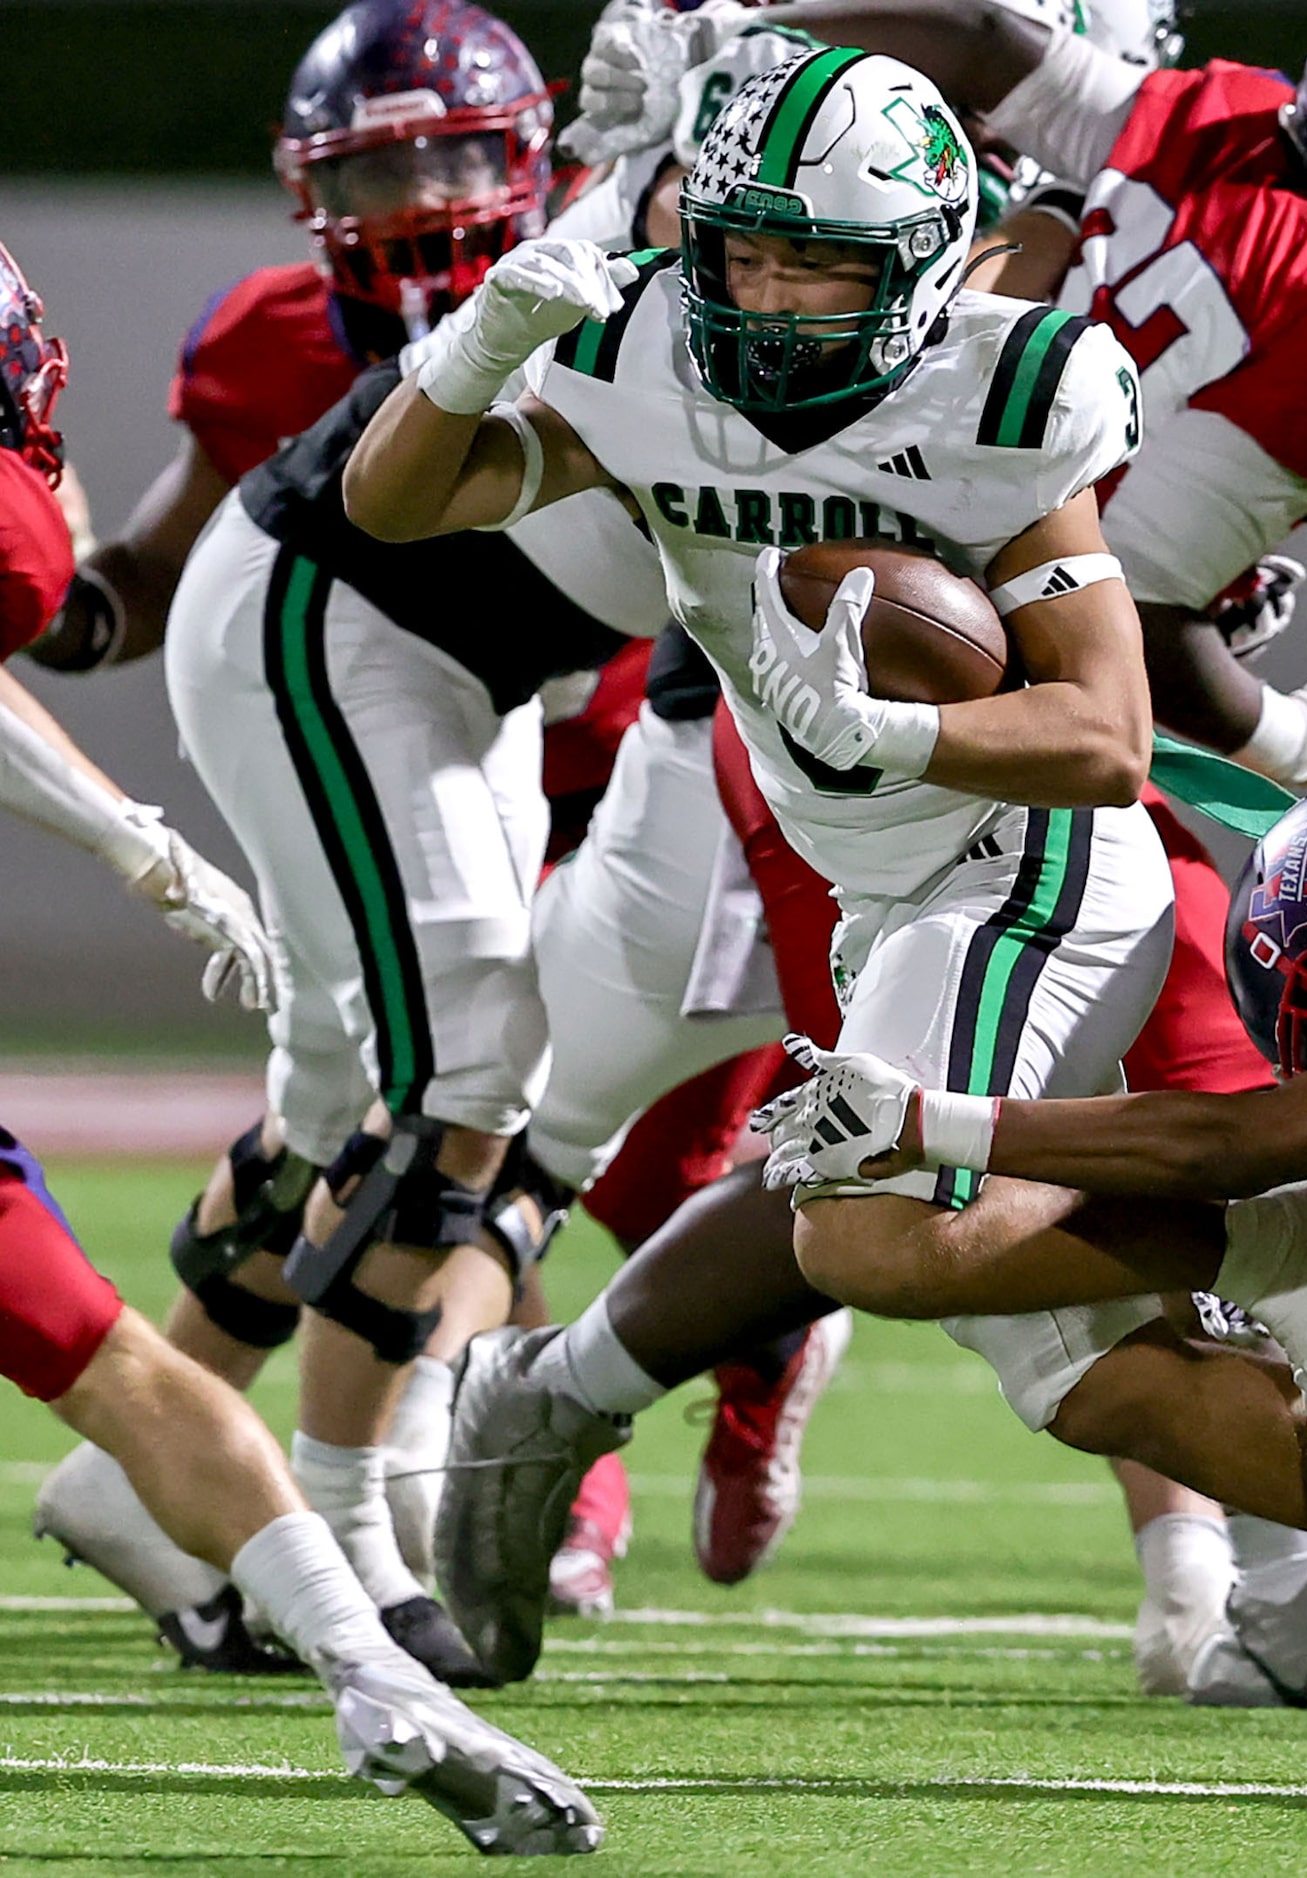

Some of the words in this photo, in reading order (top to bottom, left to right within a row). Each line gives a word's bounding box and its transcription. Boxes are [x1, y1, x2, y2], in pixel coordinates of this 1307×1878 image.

[1115, 366, 1139, 452] 3
[651, 482, 936, 549] CARROLL
[1278, 832, 1307, 902] TEXANS
